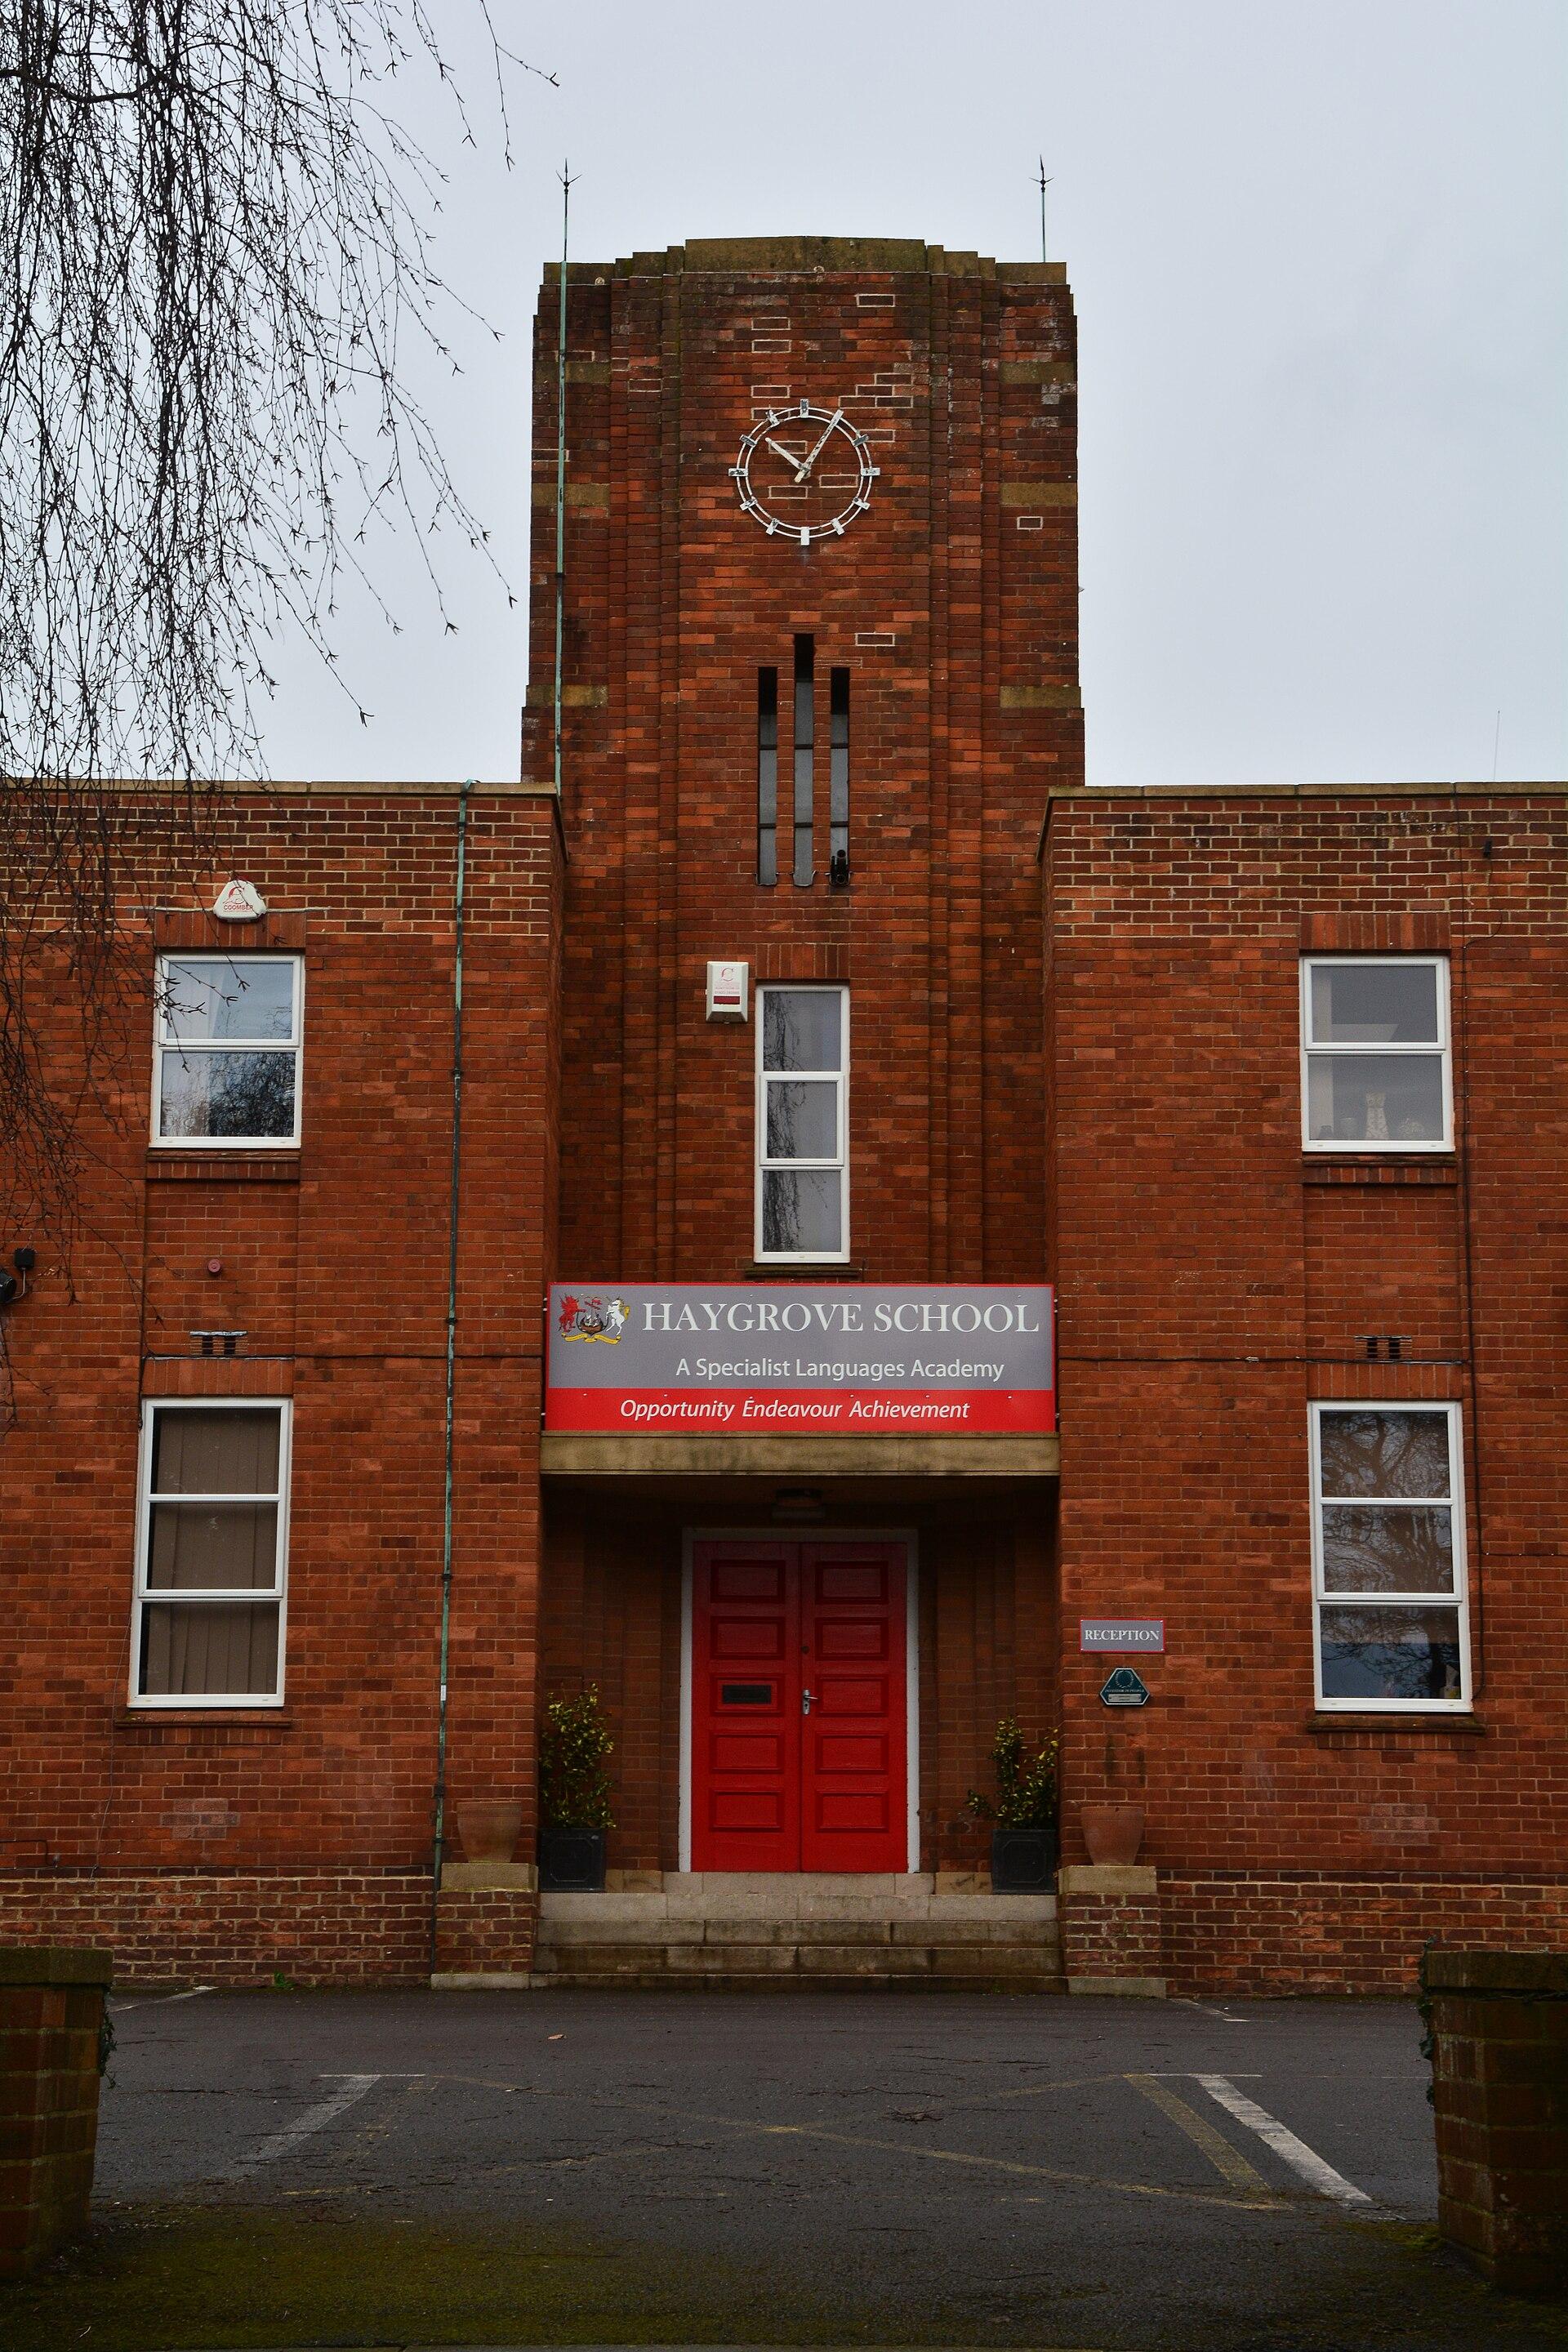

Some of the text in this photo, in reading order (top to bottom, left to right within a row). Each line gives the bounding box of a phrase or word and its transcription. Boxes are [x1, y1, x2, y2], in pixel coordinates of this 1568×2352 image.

[642, 1303, 1040, 1333] HAYGROVE SCHOOL
[675, 1357, 1004, 1383] A Specialist Languages Academy
[620, 1399, 970, 1421] Opportunity Endeavour Achievement
[1085, 1629, 1160, 1641] RECEPTION
